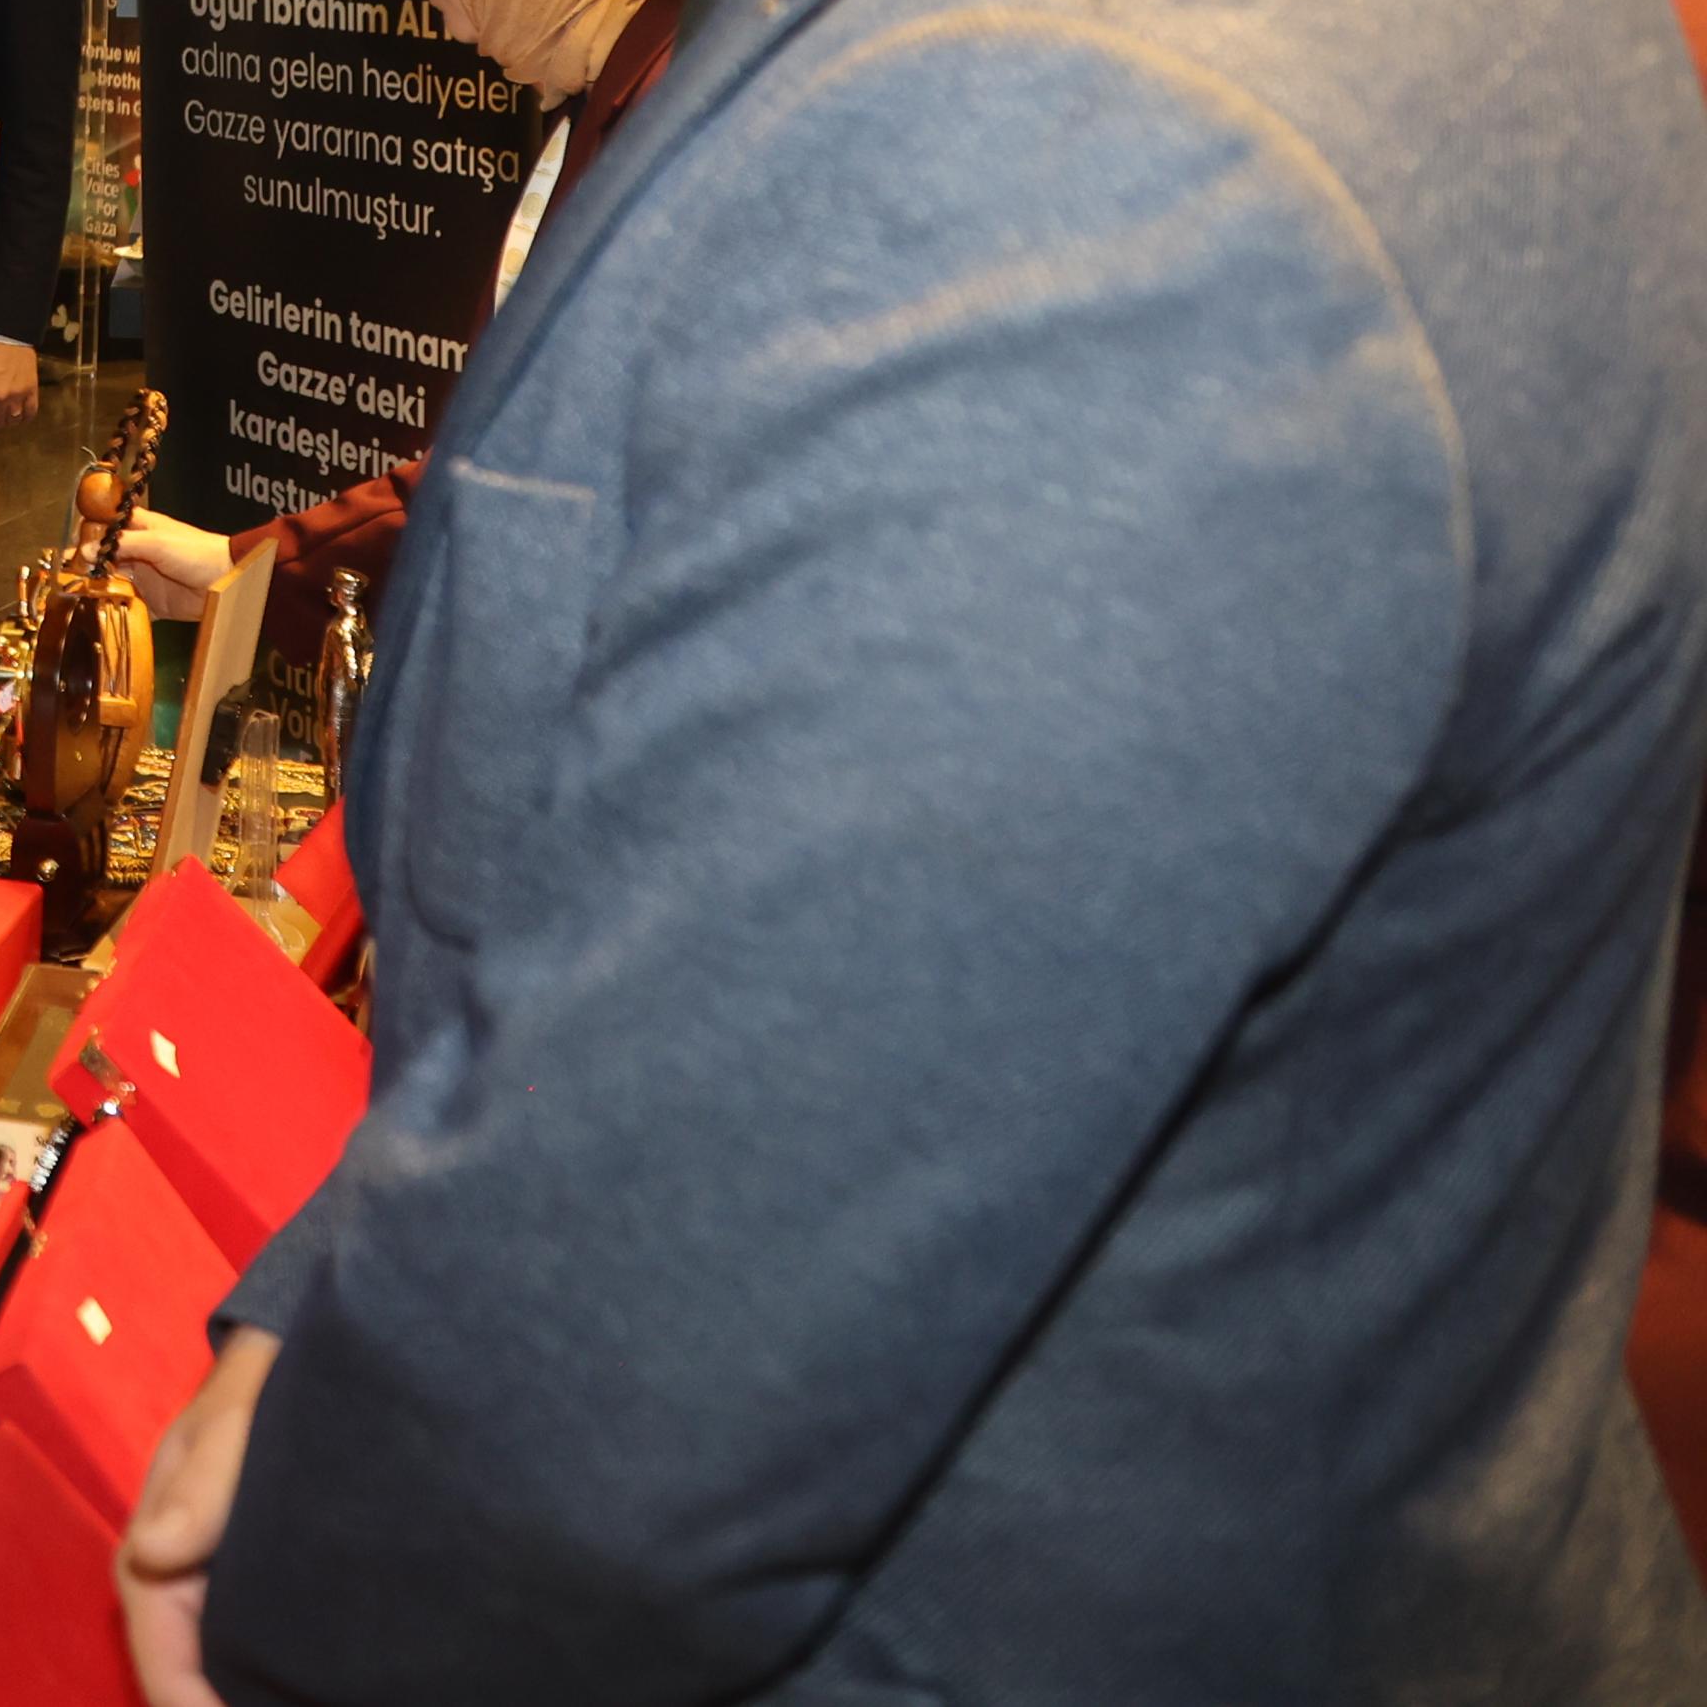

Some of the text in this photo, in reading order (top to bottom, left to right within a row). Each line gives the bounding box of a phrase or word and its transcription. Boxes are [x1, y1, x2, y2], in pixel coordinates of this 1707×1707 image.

[396, 0, 454, 42] AL
[182, 42, 523, 119] adına gelen hediyeler
[184, 99, 520, 193] Gazze yararına satışa
[243, 174, 441, 240] sunulmuştur.
[209, 279, 342, 343] Gelirlerin
[257, 351, 426, 428] Gazze'deki
[225, 463, 337, 519] ulaştır
